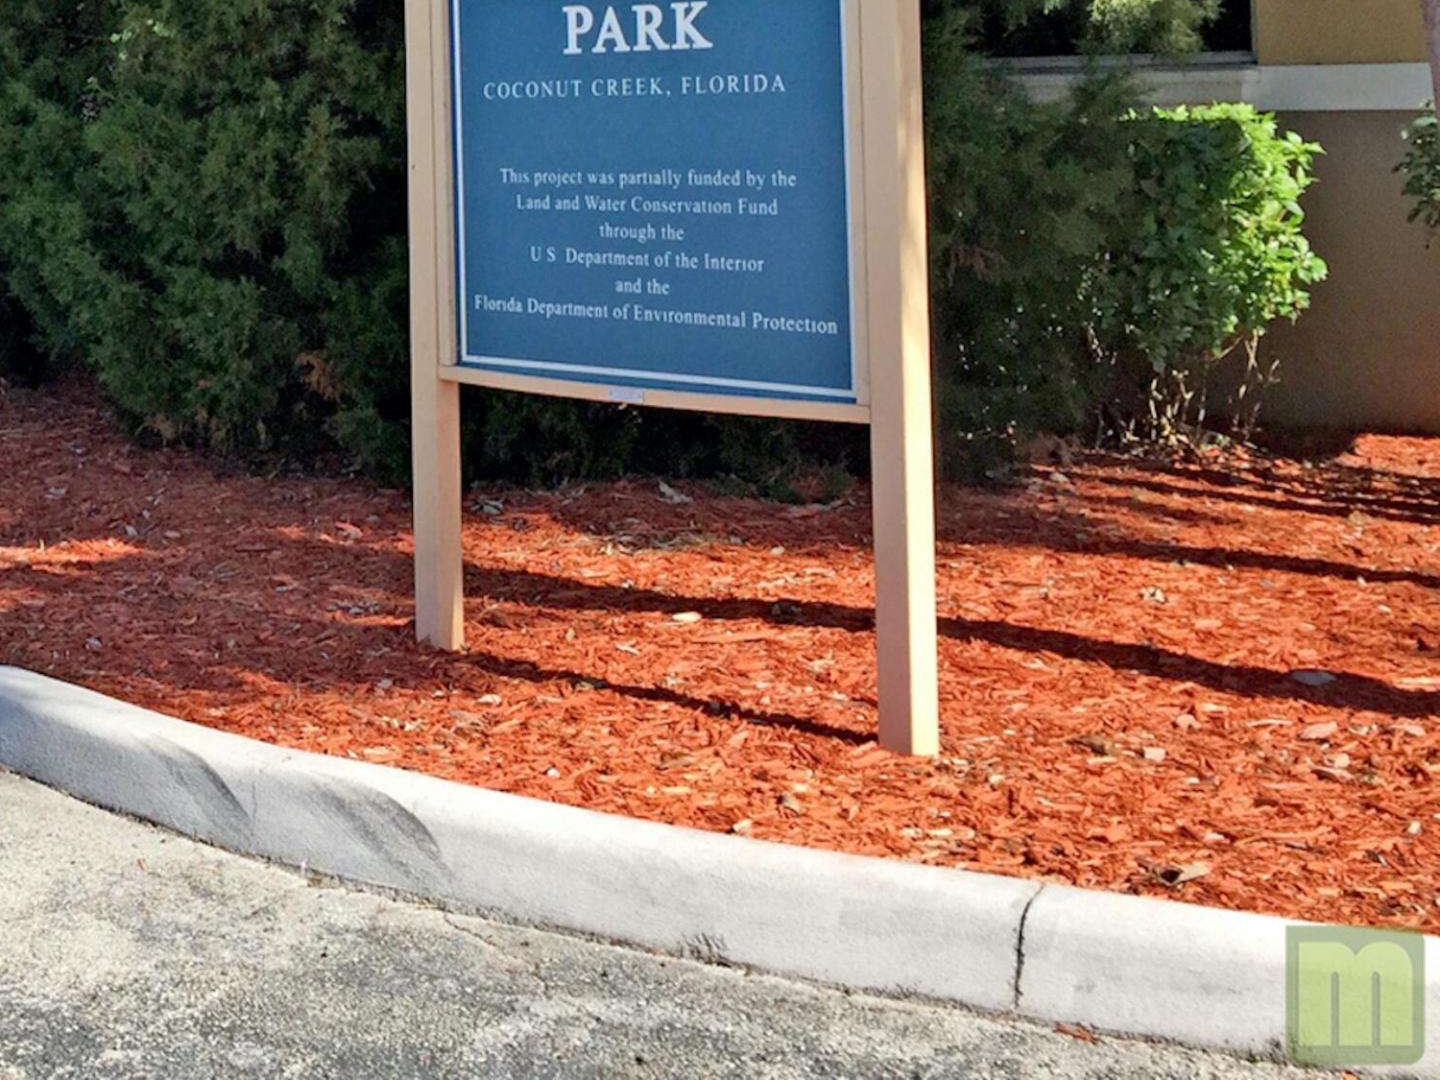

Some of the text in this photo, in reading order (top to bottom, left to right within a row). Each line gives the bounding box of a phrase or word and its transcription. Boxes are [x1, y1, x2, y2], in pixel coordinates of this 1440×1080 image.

[562, 1, 713, 55] PARK
[483, 74, 786, 100] COCONUT CREEK, FLORIDA
[500, 168, 797, 191] This project was partially funded by the
[516, 194, 778, 216] Land and Water Conservation Fund
[599, 222, 685, 243] through the
[565, 247, 649, 269] Department
[654, 251, 672, 267] of
[676, 252, 699, 269] the
[705, 253, 765, 272] Interior
[616, 278, 670, 295] and the
[474, 294, 838, 334] Florida Department of Environmental Protection
